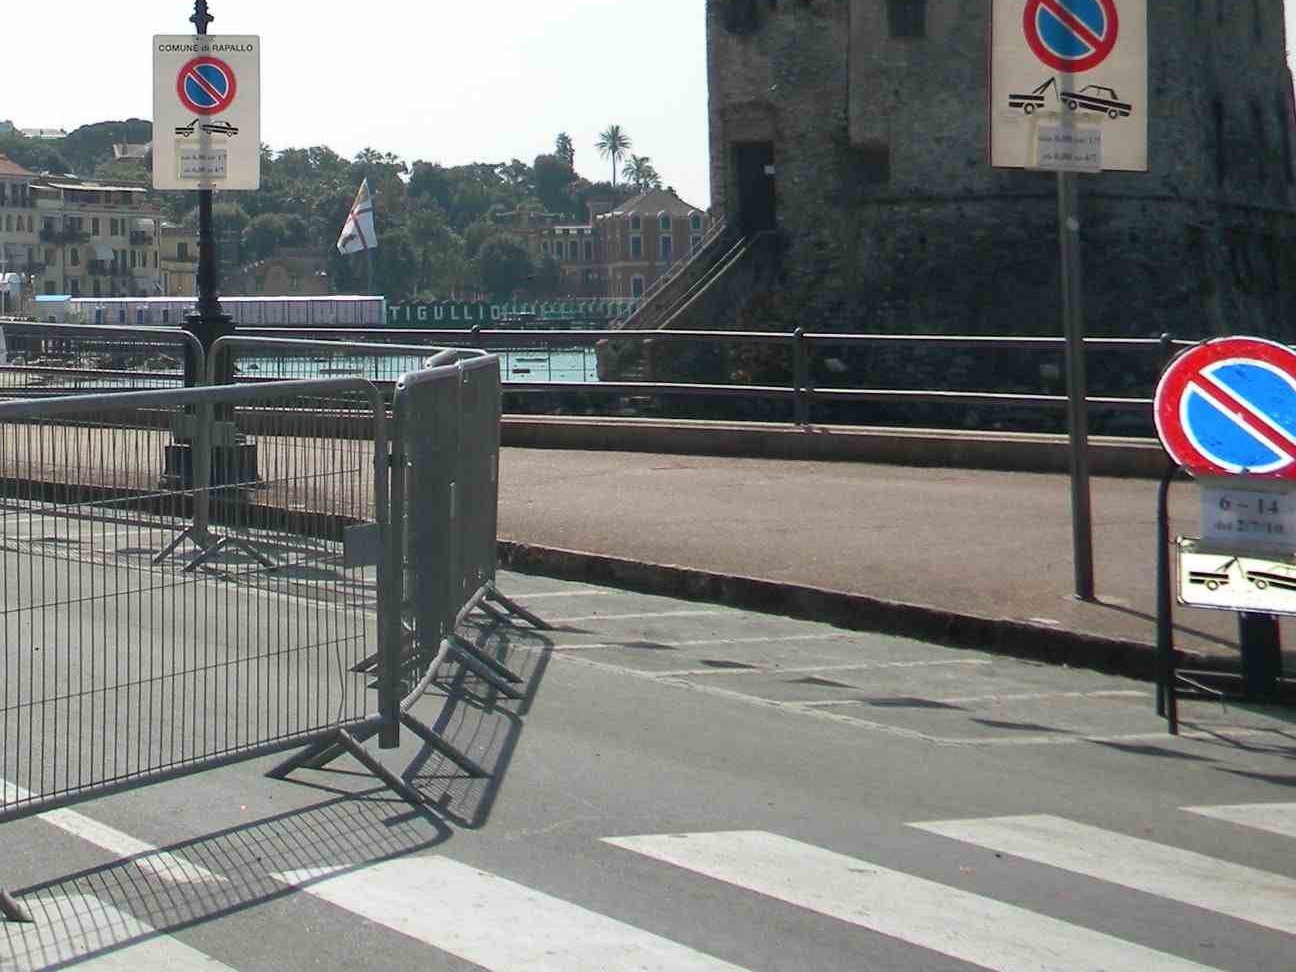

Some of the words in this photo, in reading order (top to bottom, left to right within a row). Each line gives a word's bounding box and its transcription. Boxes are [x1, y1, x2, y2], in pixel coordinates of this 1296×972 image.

[158, 44, 198, 52] COMUNE
[212, 44, 253, 52] RAPALLO
[389, 305, 501, 321] TIGULLIO
